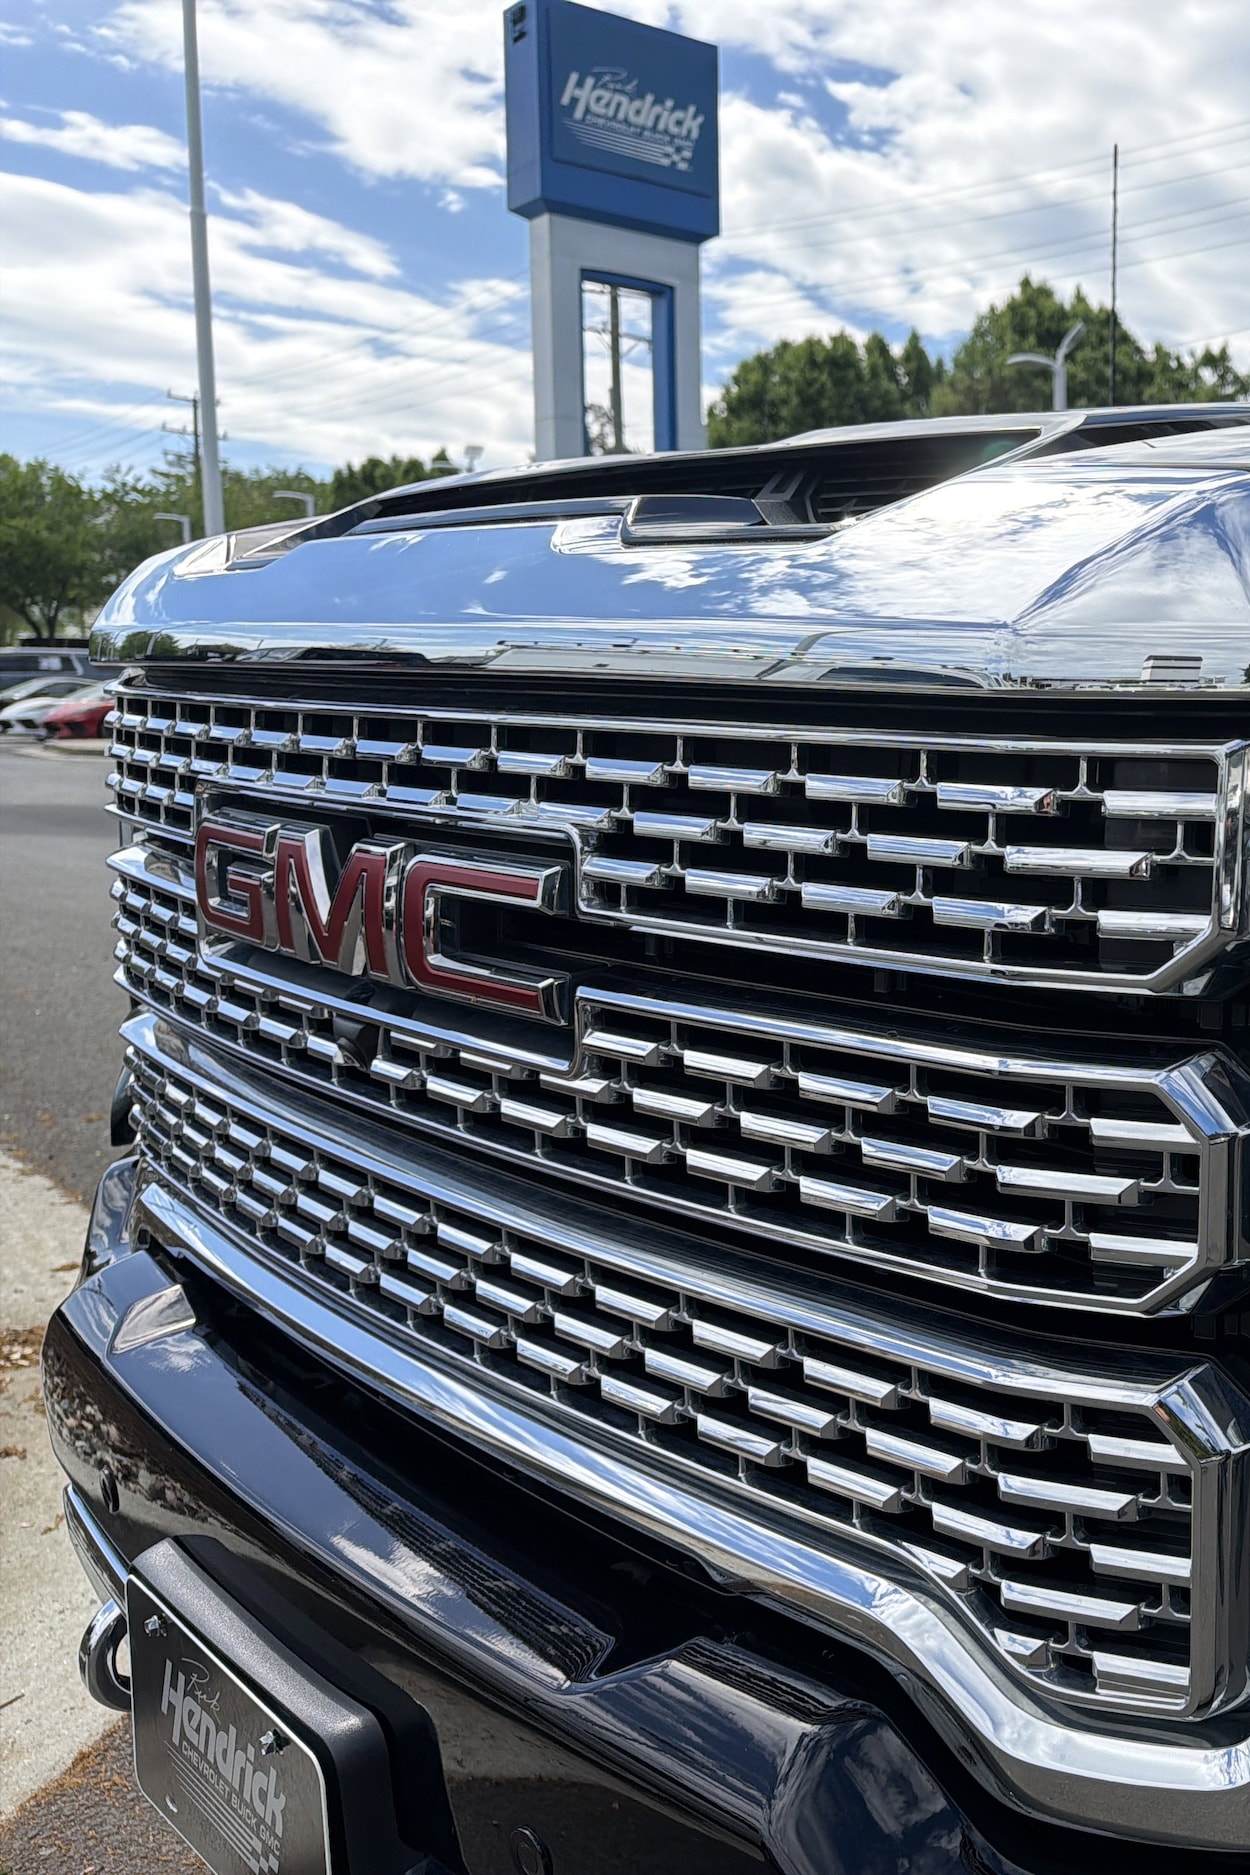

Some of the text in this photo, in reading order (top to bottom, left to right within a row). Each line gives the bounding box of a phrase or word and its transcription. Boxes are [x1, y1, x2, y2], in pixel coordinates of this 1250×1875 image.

[560, 71, 705, 140] Hendrick
[195, 812, 567, 1026] GMC
[161, 1657, 286, 1838] Hendrick
[182, 1742, 281, 1856] CHEVROLET BUICK GMC
